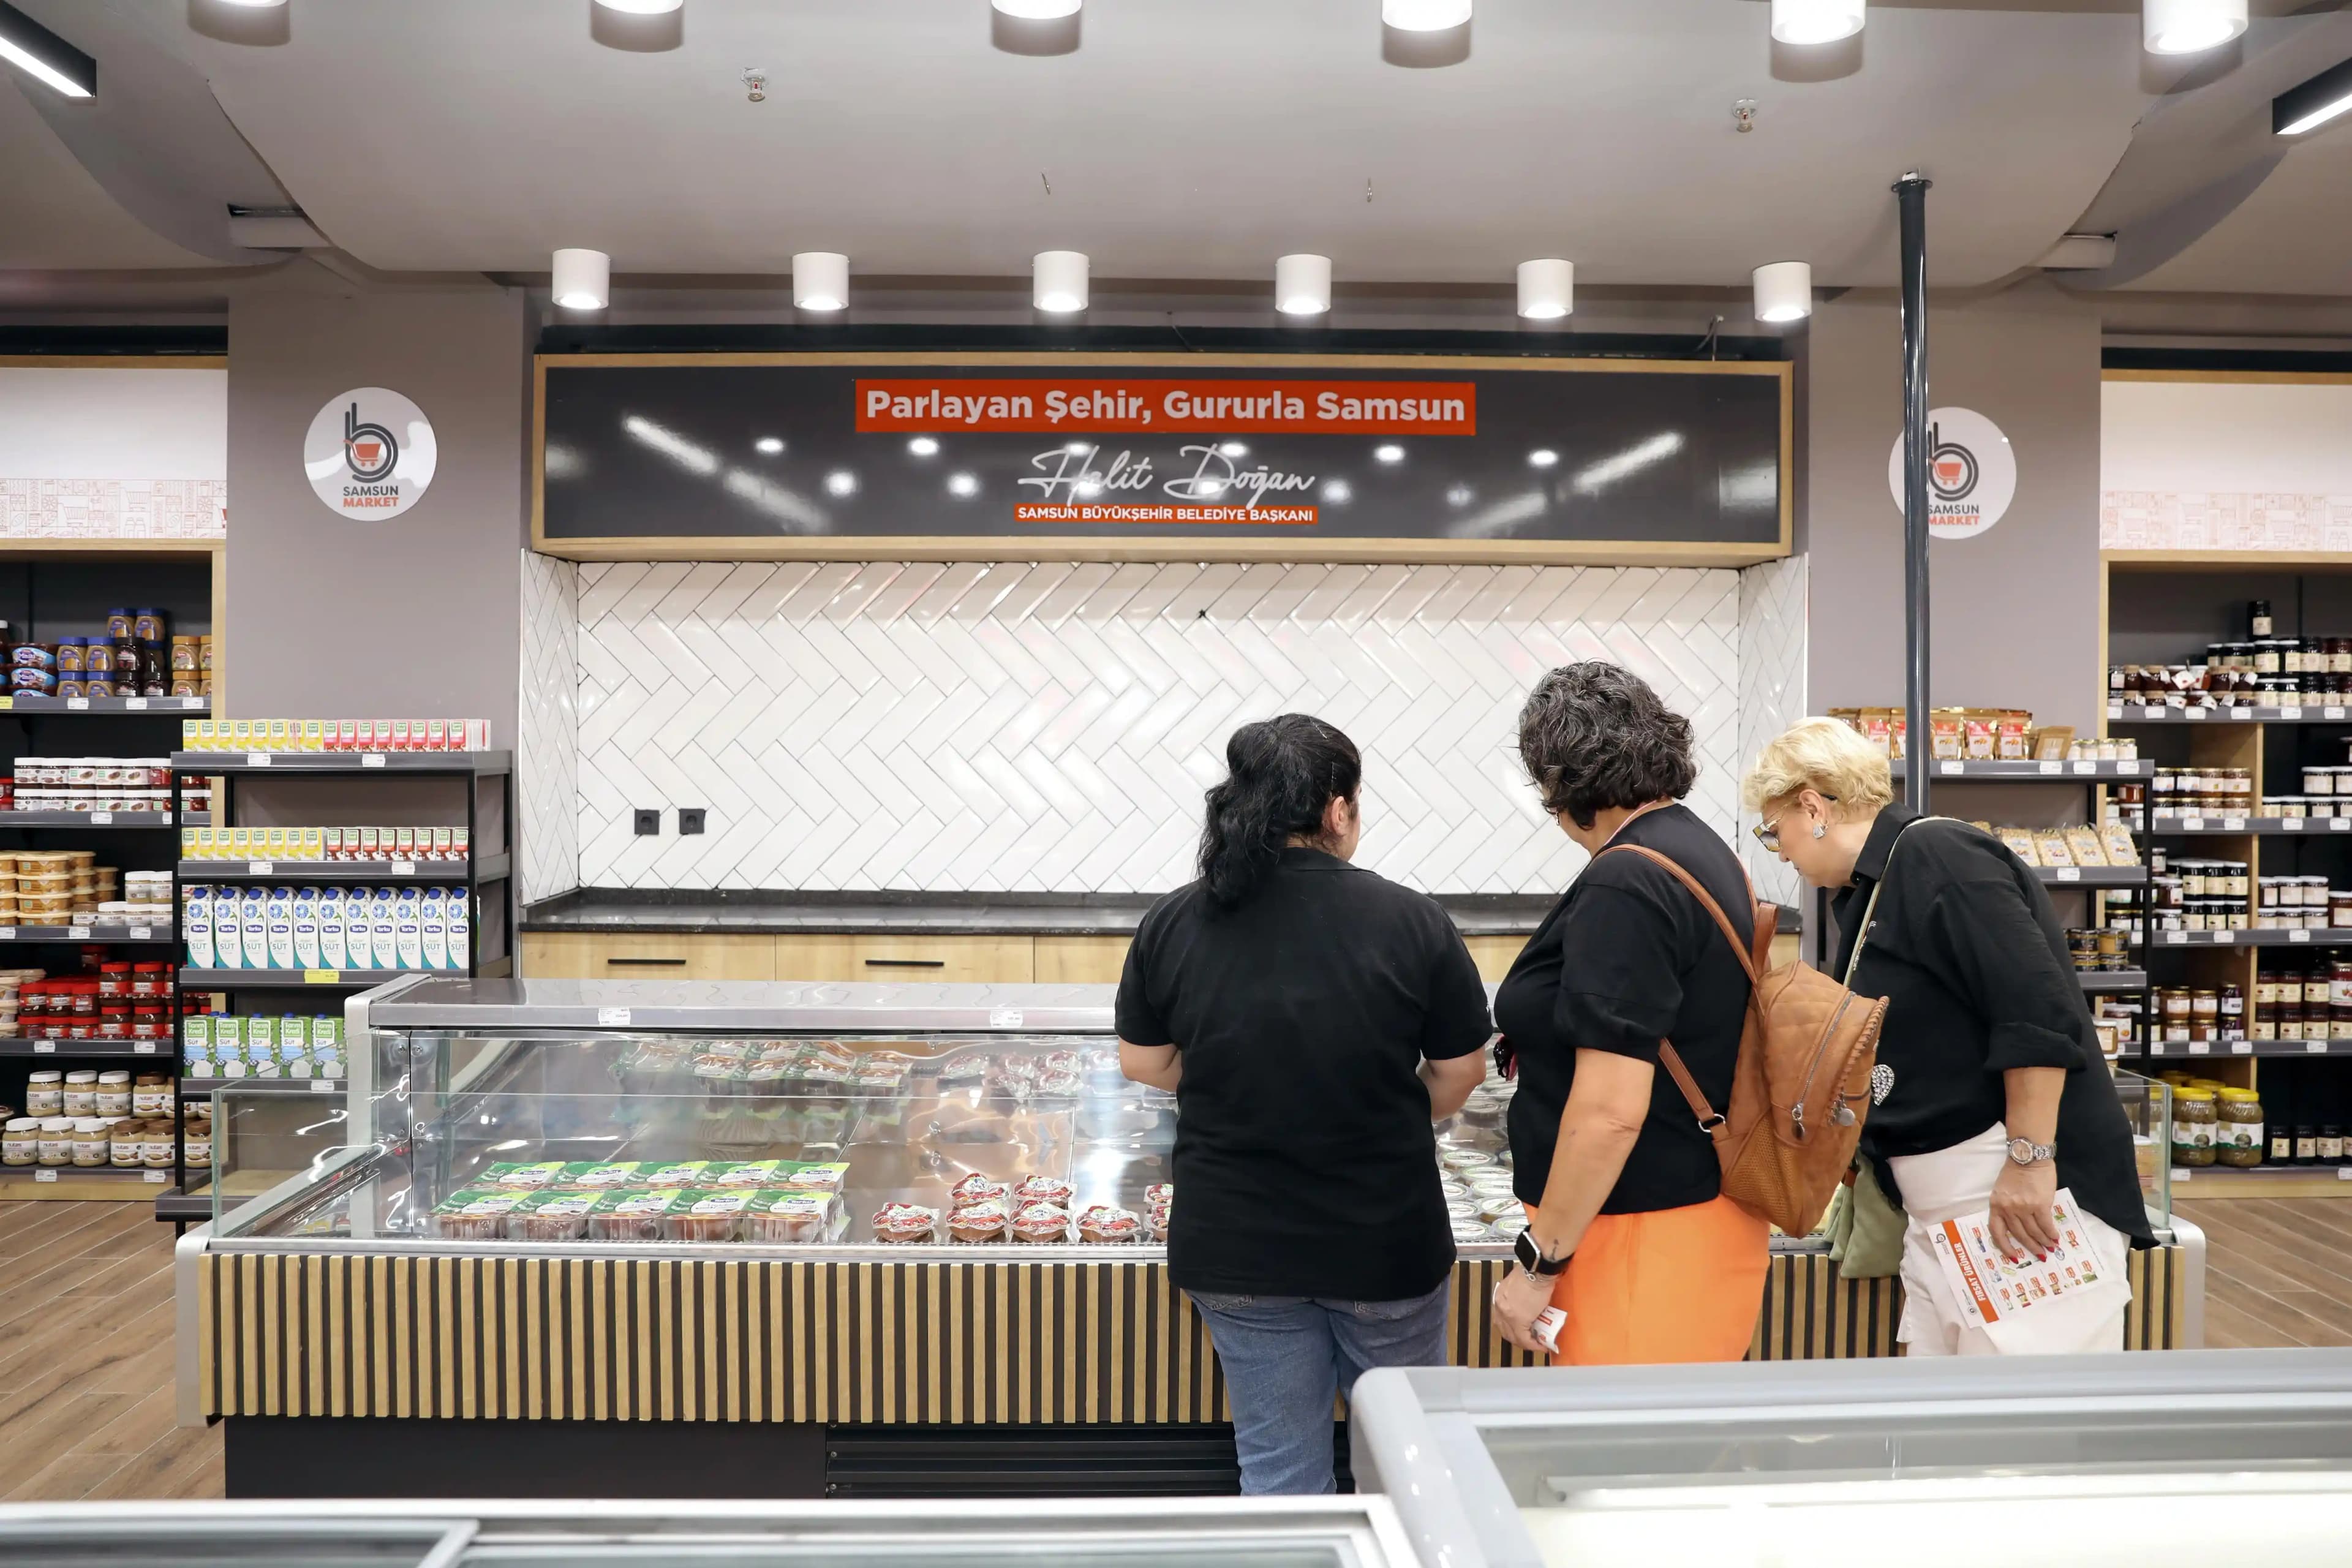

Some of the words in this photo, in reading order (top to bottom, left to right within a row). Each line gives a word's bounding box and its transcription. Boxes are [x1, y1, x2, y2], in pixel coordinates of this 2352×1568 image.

[867, 390, 1032, 424] Parlayan
[1045, 390, 1151, 424] Şehir,
[1164, 391, 1304, 419] Gururla
[1317, 392, 1464, 421] Samsun
[1018, 444, 1154, 507] Halit
[1164, 444, 1315, 510] Doğan
[343, 485, 399, 497] SAMSUN
[343, 497, 399, 507] MARKET
[1019, 507, 1078, 519] SAMSUN
[1082, 505, 1173, 521] BÜYÜKŞEHİR
[1177, 506, 1246, 521] BELEDİYE
[1250, 509, 1313, 522] BAŞKANI
[1954, 1242, 1974, 1276] ÜRÜNLER
[1969, 1277, 1986, 1302] FIRSAT
